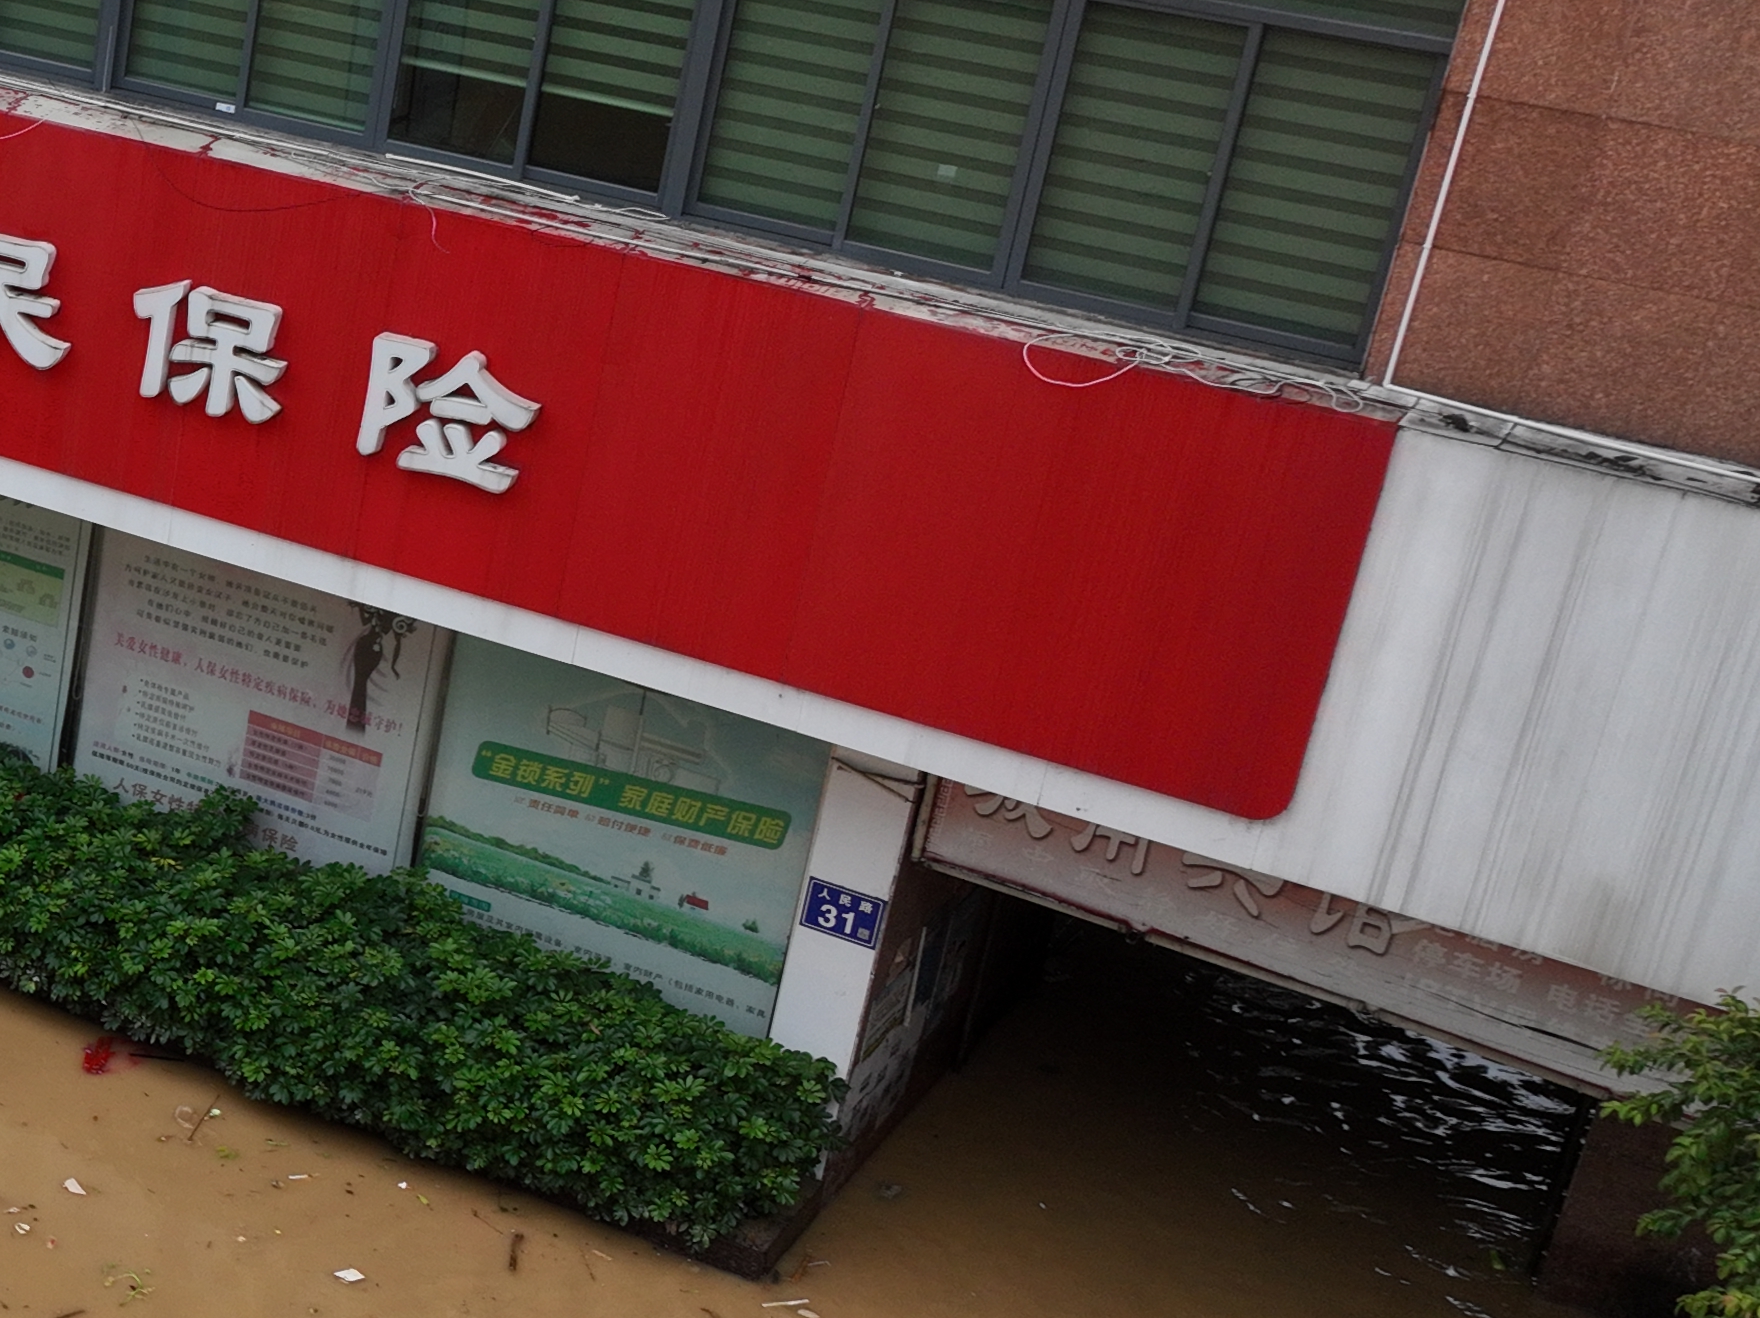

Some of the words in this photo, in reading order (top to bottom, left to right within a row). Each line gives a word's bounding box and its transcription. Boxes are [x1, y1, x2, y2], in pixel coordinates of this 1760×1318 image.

[619, 784, 785, 844] 家庭财产保险
[818, 888, 873, 914] 人民路
[818, 904, 855, 934] 31
